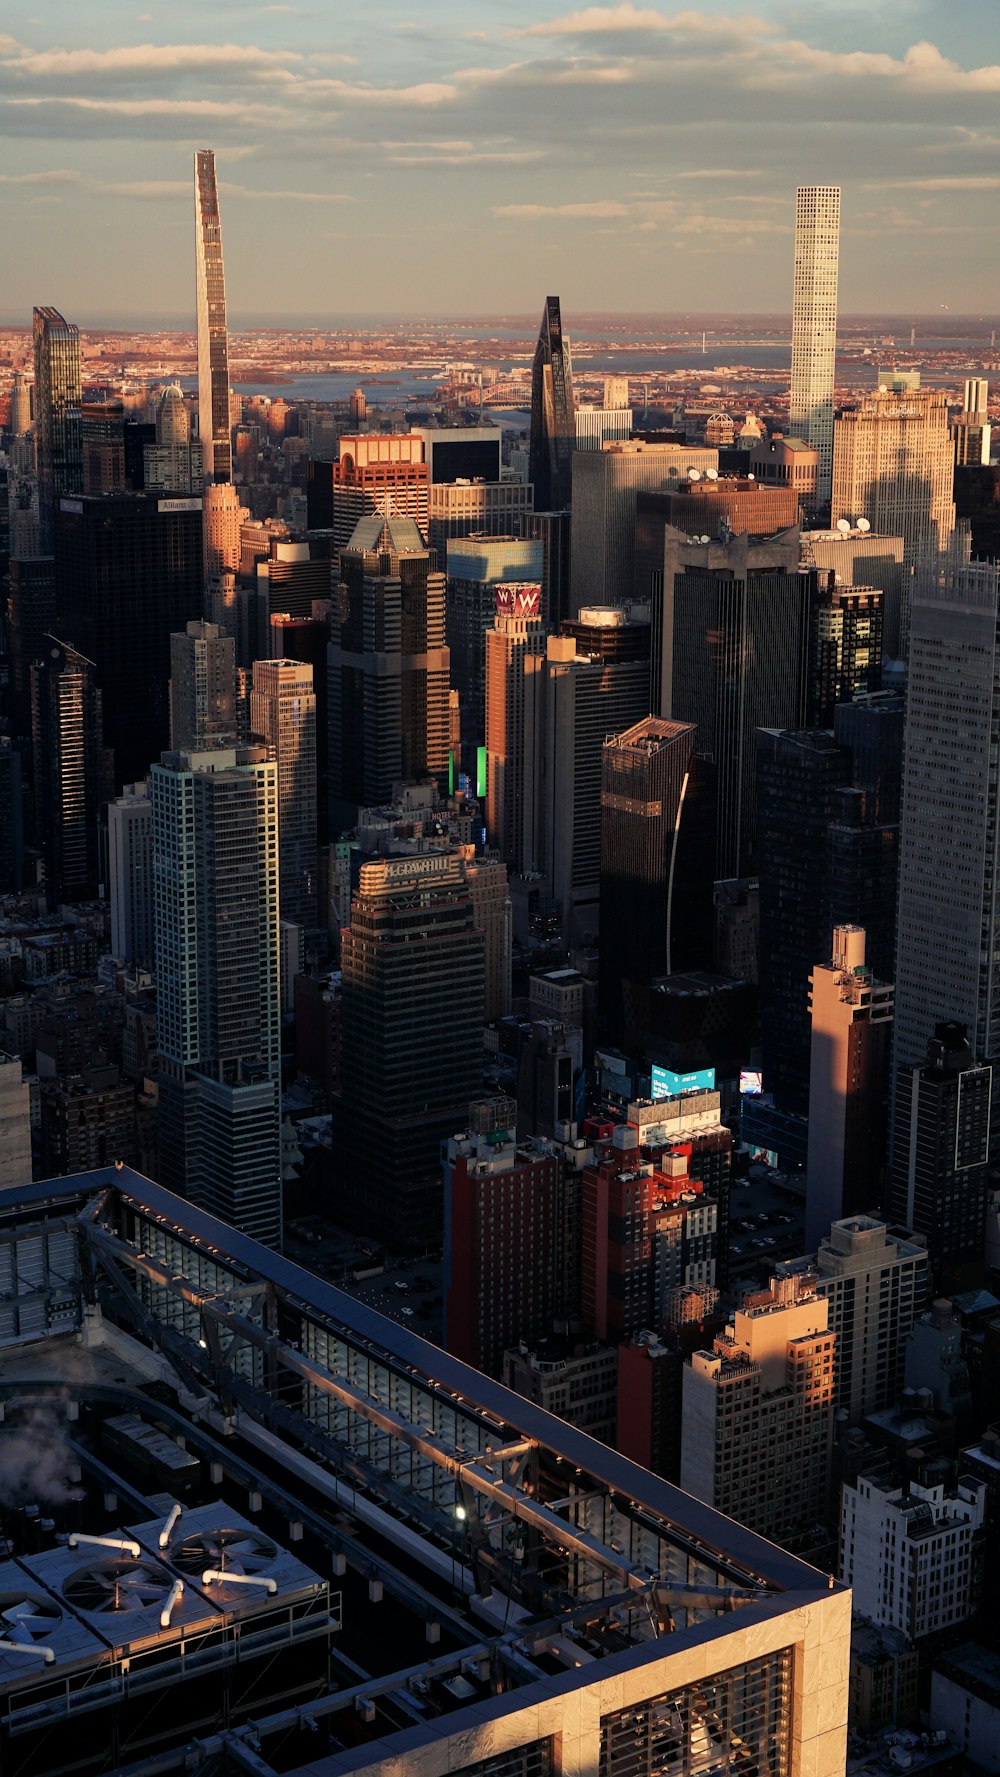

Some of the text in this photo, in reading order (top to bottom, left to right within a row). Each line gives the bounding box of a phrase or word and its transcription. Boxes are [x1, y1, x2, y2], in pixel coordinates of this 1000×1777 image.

[498, 590, 508, 603] W
[519, 593, 537, 608] W
[432, 812, 451, 820] HOTEL
